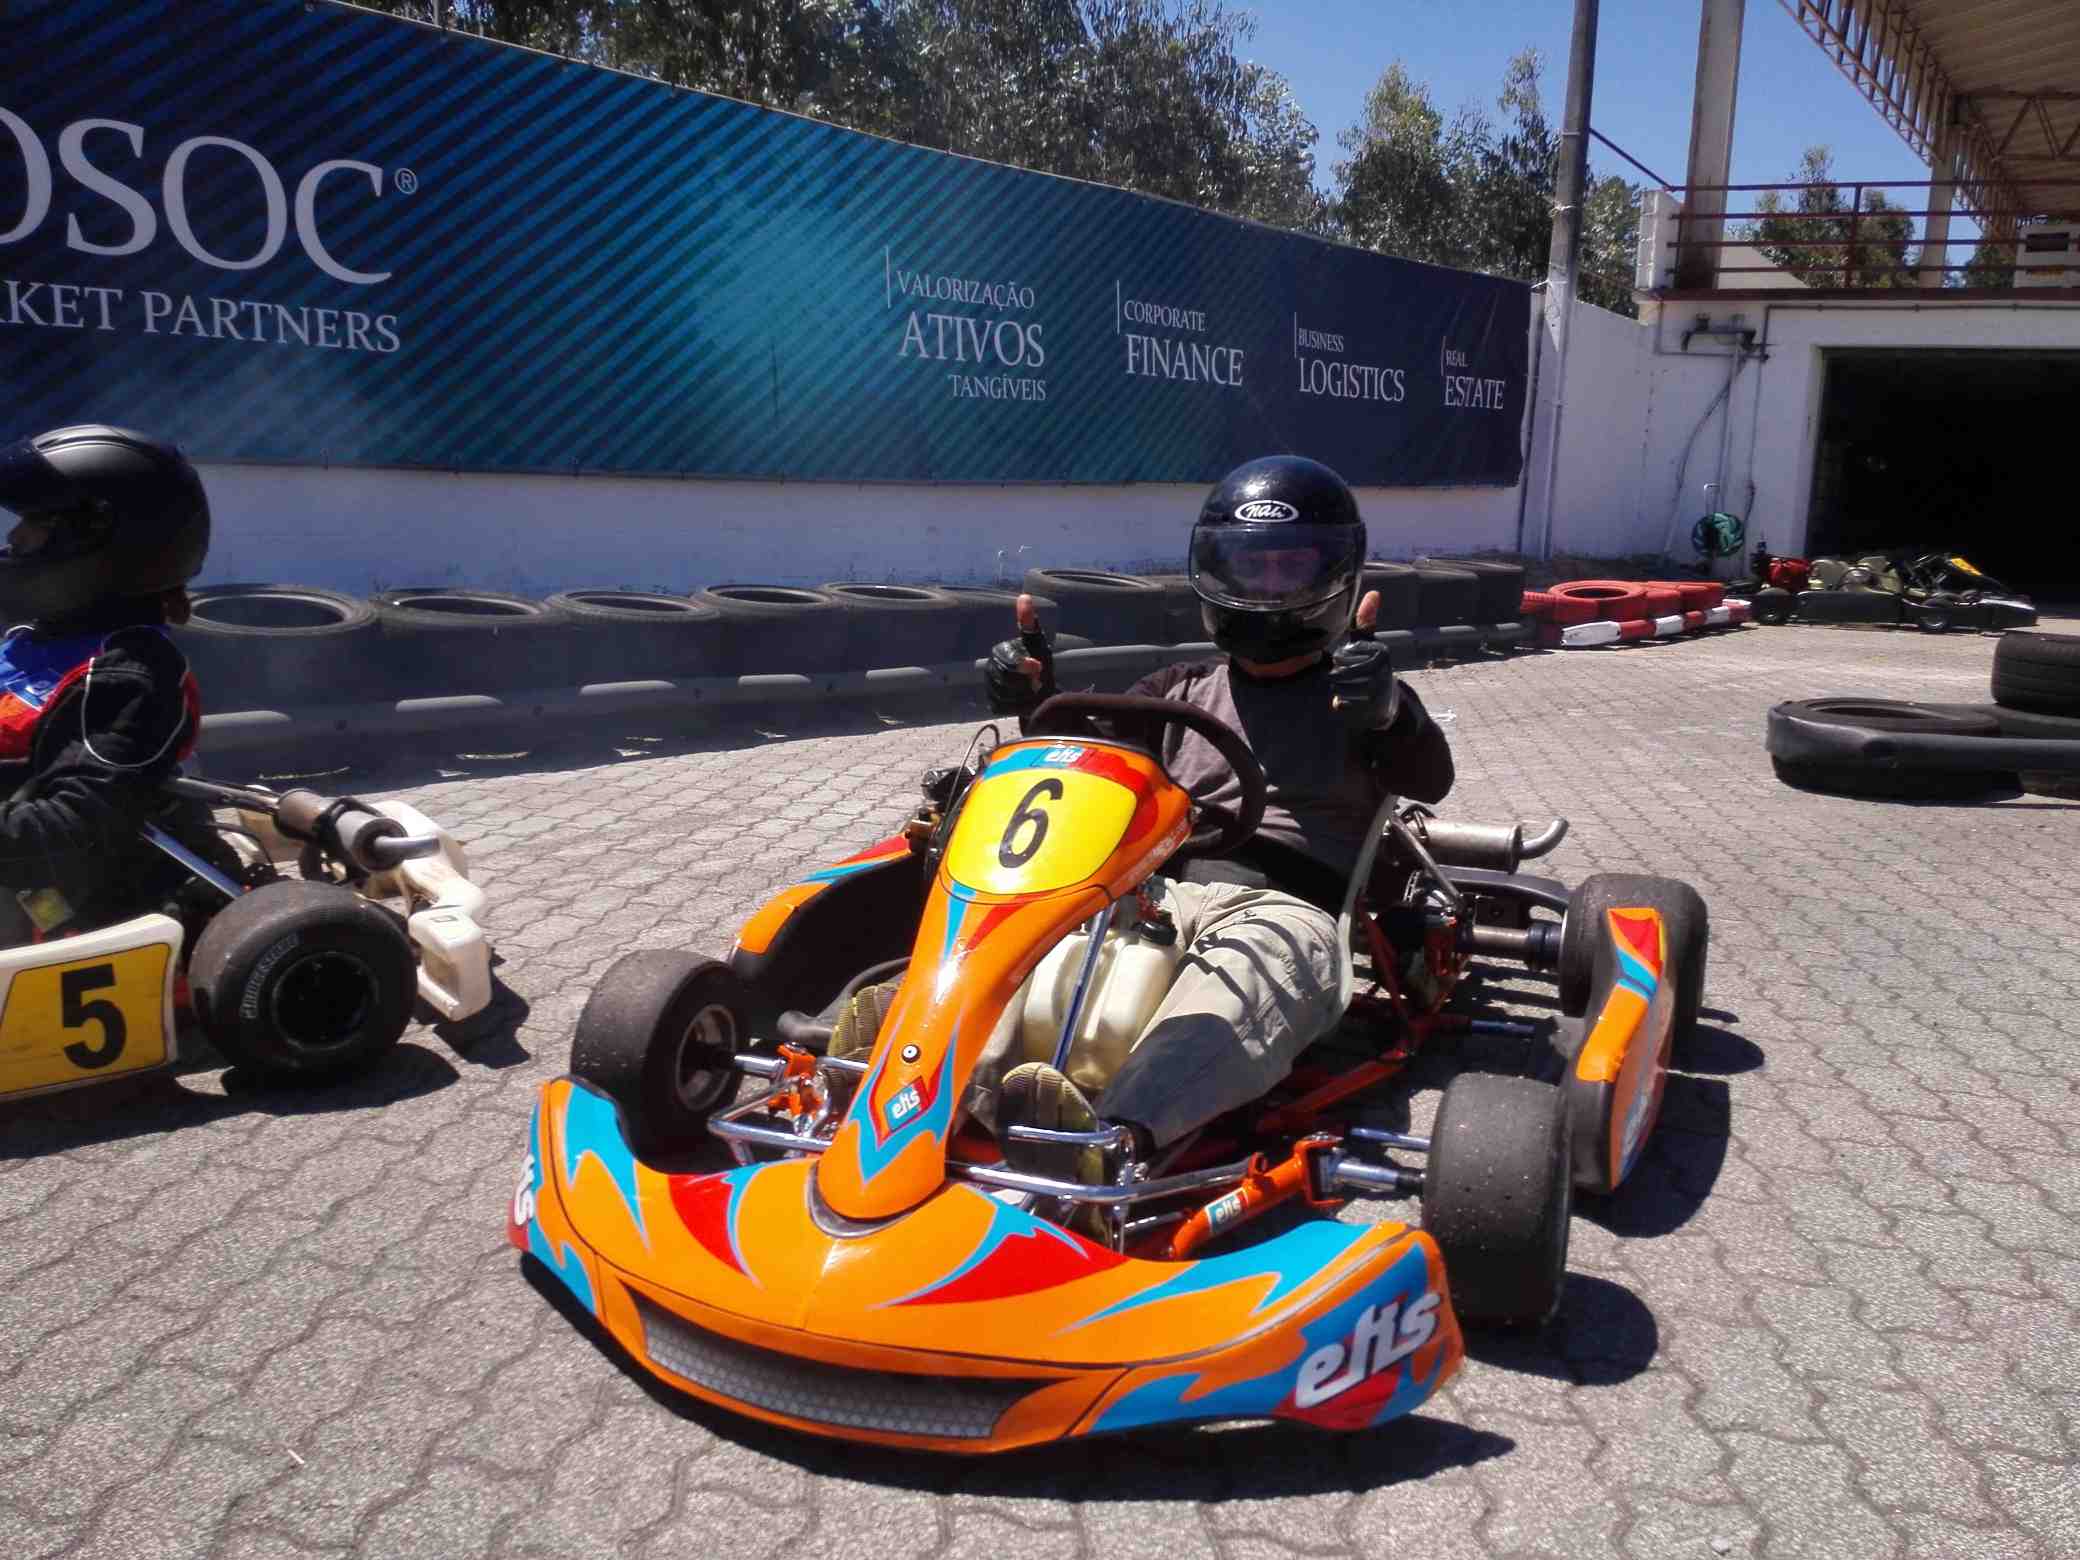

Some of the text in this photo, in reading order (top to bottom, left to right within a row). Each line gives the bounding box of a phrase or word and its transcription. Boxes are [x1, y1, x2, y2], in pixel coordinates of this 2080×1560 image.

[896, 270, 1035, 313] VALORIZAÇÃO
[0, 279, 402, 353] KET PARTNERS
[1124, 300, 1206, 332] CORPORATE
[897, 311, 1045, 368] ATIVOS
[1125, 333, 1244, 387] FINANCE
[1298, 328, 1344, 352] BUSINESS
[1446, 349, 1470, 367] REAL
[947, 372, 1047, 401] TANGÍVEIS
[1299, 358, 1405, 402] LOGISTICS
[1444, 375, 1504, 409] ESTATE
[998, 777, 1064, 869] 6
[61, 963, 127, 1070] 5
